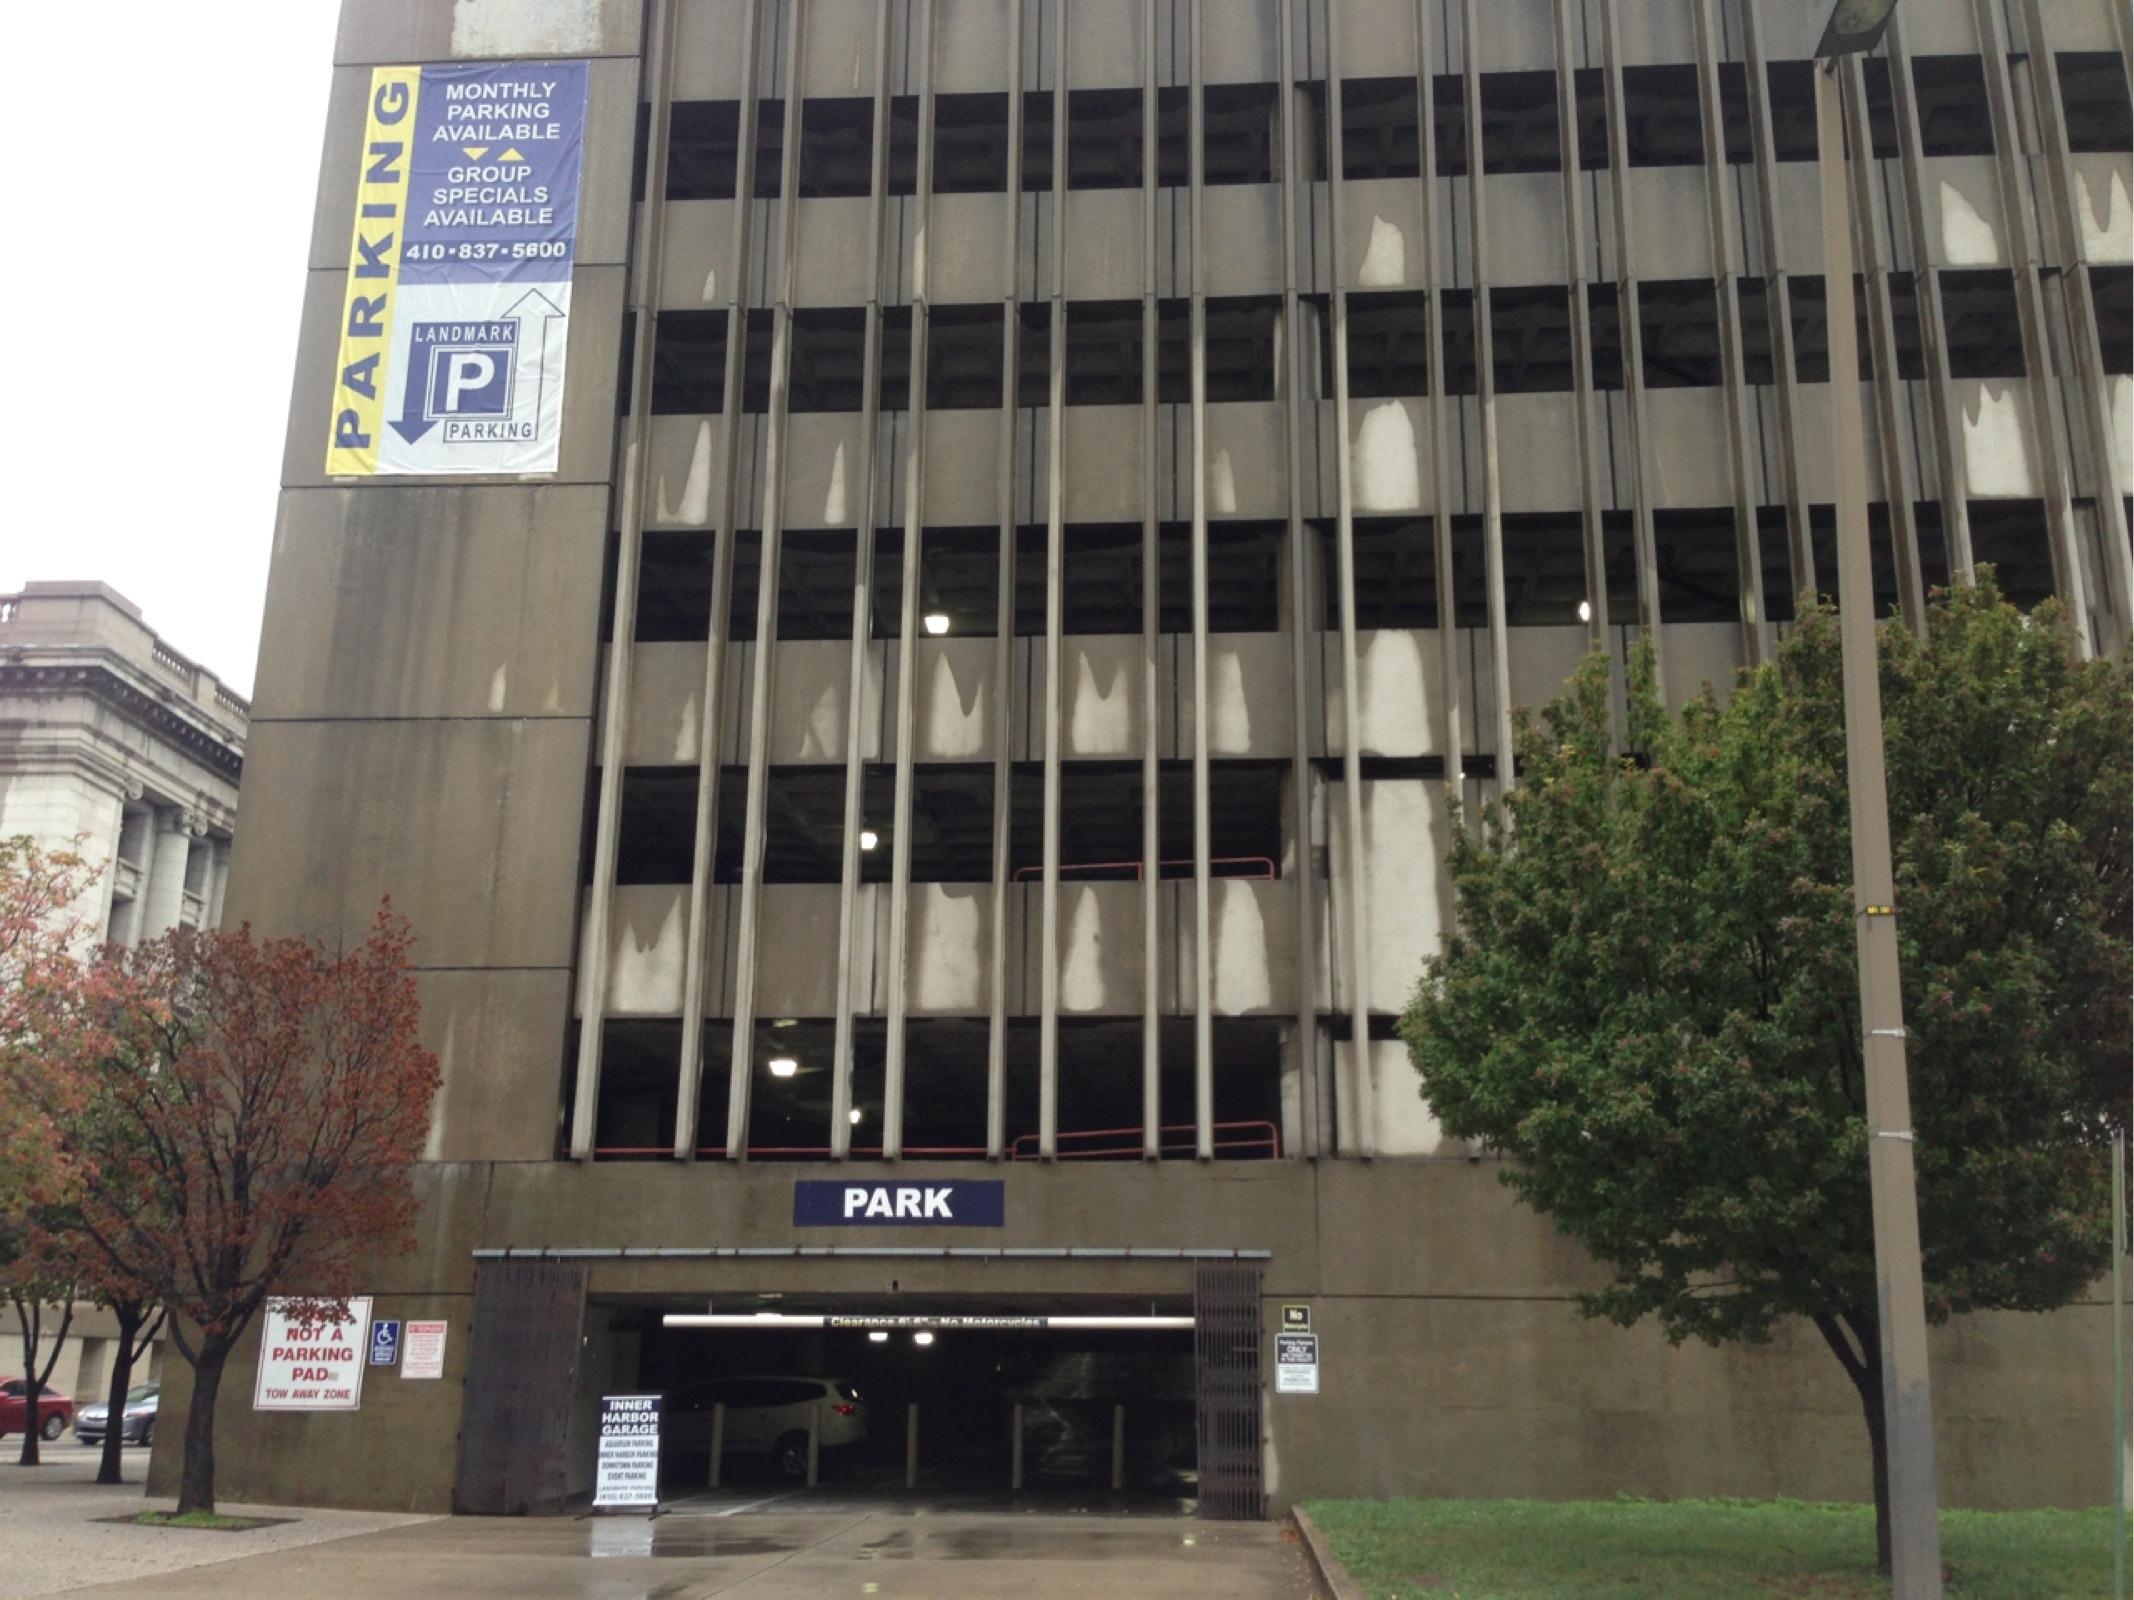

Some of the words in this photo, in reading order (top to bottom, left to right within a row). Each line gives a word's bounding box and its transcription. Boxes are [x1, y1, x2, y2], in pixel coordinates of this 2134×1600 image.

[446, 82, 557, 100] MONTHLY
[447, 103, 550, 120] PARKING
[432, 123, 561, 142] AVAILABLE
[447, 166, 532, 183] GROUP
[433, 187, 548, 204] SPECIALS
[423, 208, 553, 226] AVAILABLE
[334, 82, 410, 450] PARKING
[415, 325, 513, 343] LANDMARK
[446, 353, 496, 412] P
[449, 422, 532, 439] PARKING
[844, 1187, 953, 1218] PARK
[286, 1328, 323, 1341] NOT
[332, 1328, 343, 1341] A
[272, 1347, 353, 1361] PARKING
[292, 1368, 329, 1381] PAD
[266, 1390, 288, 1399] TOW
[292, 1390, 320, 1399] AWAY
[323, 1390, 351, 1399] ZONE
[609, 1400, 652, 1410] INNER
[602, 1412, 658, 1422] HARBOR
[602, 1424, 658, 1435] GARAGE
